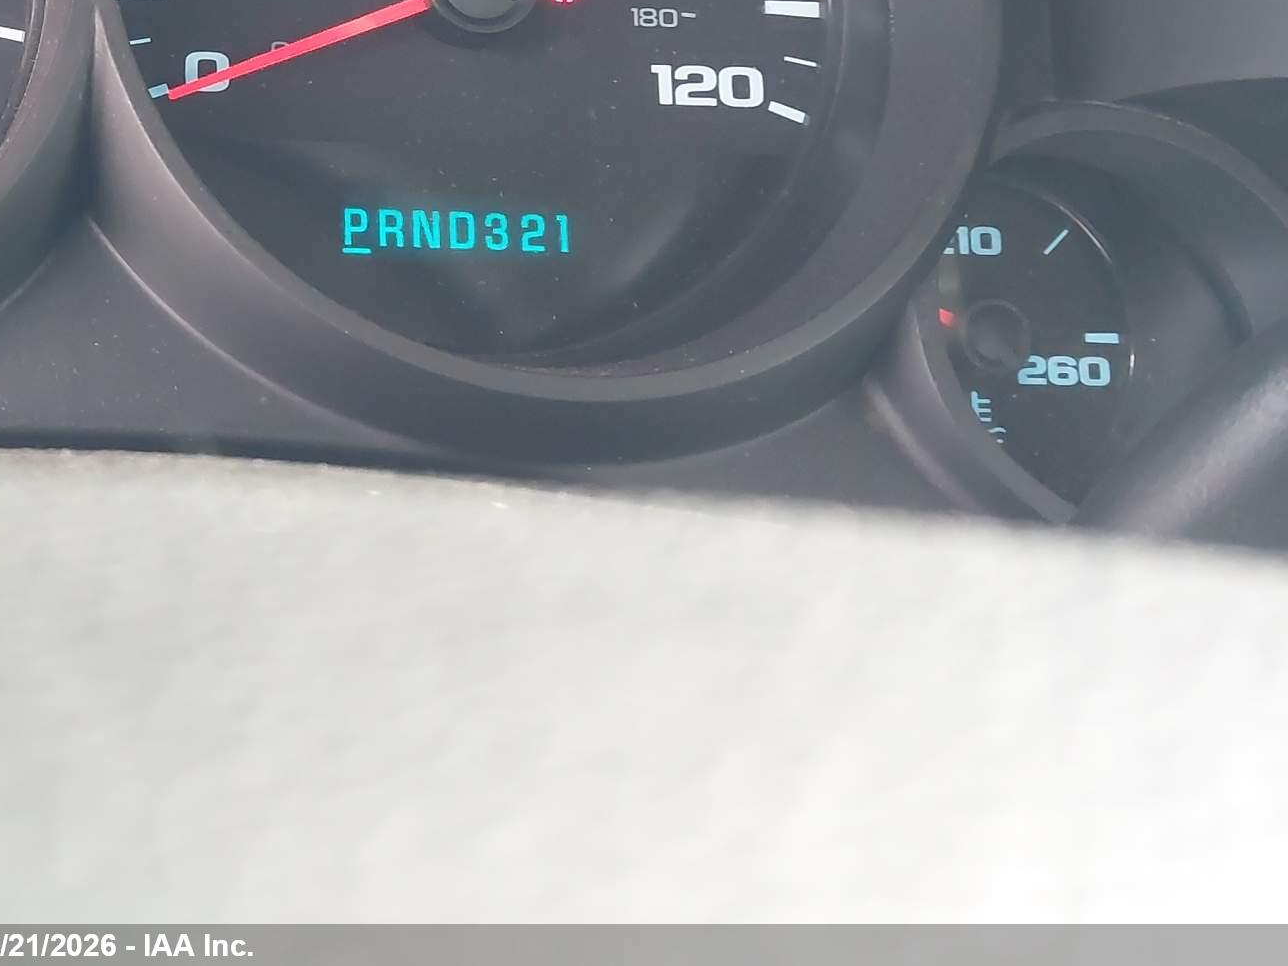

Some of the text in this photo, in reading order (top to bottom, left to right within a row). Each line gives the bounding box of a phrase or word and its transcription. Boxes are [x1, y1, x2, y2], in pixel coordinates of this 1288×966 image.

[630, 7, 678, 28] 180
[185, 51, 230, 92] 0
[650, 64, 765, 109] 120
[943, 226, 1002, 256] 10
[1017, 355, 1111, 387] 260
